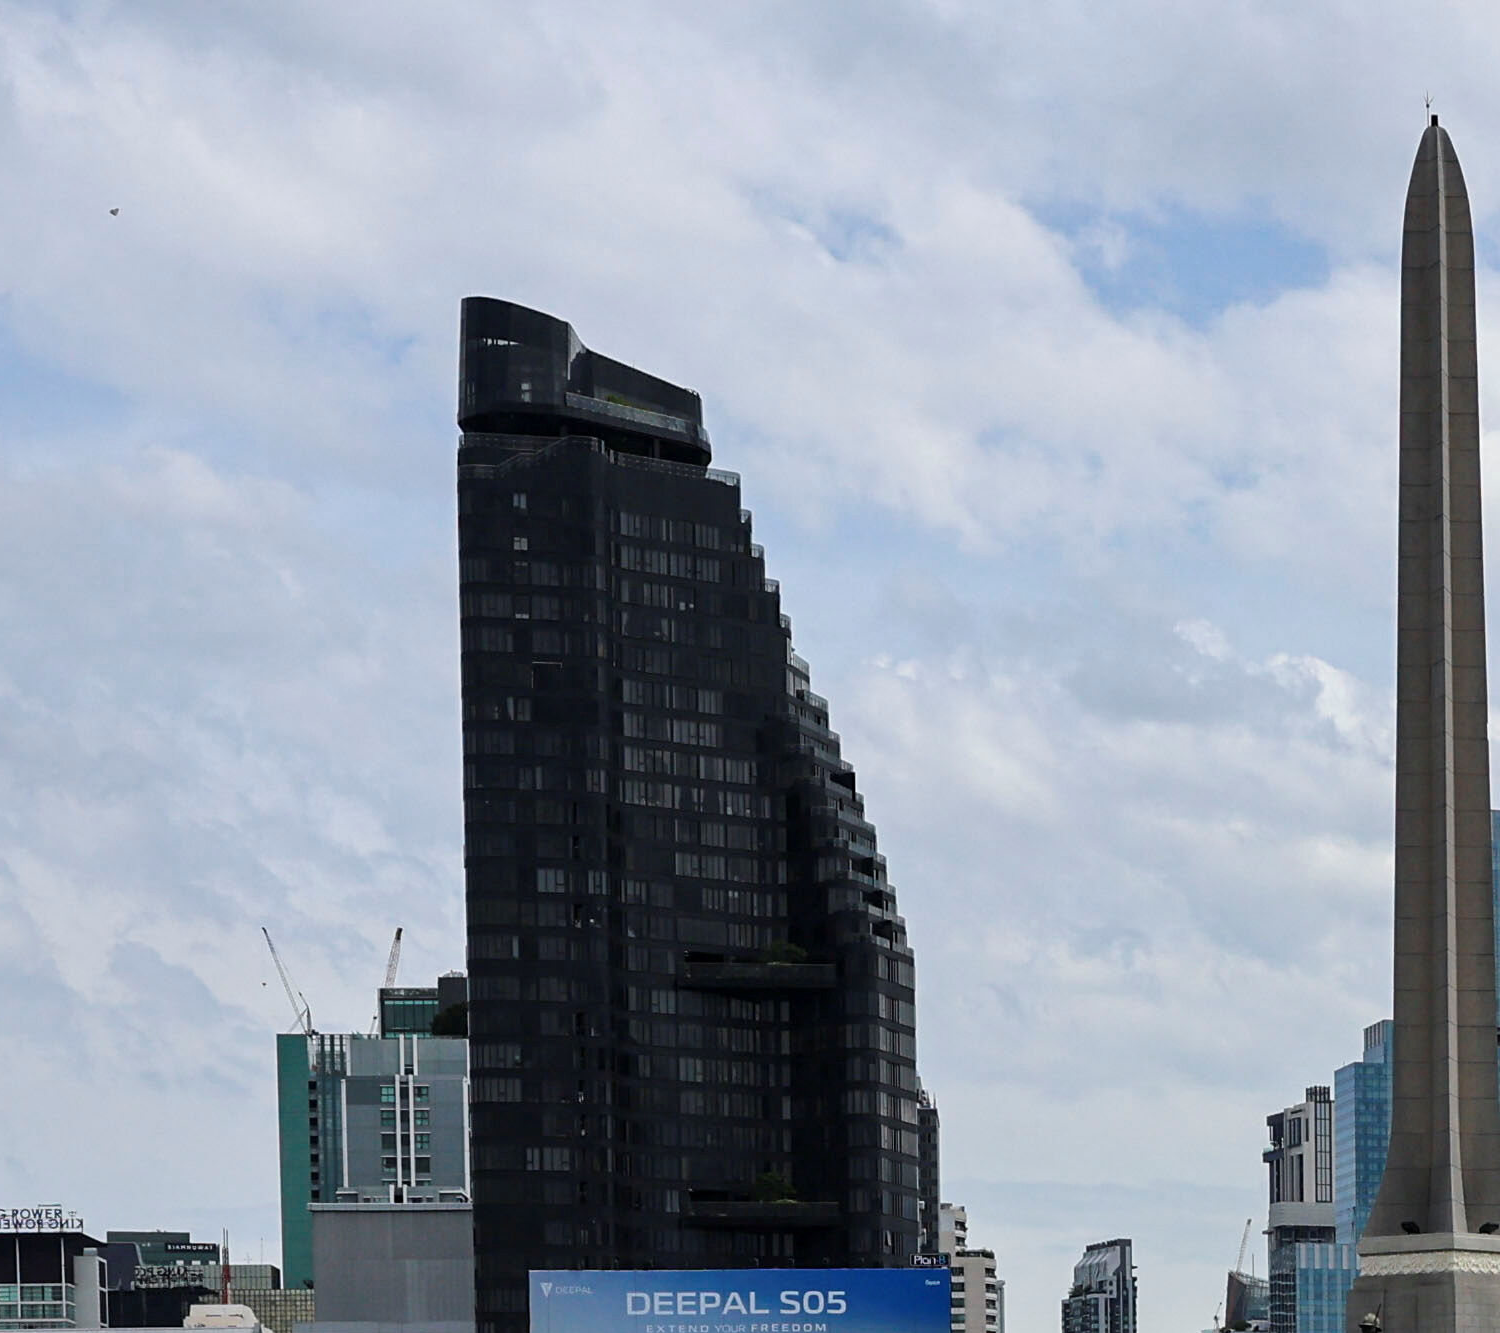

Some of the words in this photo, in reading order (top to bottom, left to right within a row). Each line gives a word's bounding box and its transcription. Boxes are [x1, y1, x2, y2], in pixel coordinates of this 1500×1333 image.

[555, 1286, 592, 1295] DEEPAL
[627, 1292, 769, 1316] DEEPAL
[780, 1290, 846, 1315] S05
[646, 1324, 709, 1333] EXTEND
[714, 1324, 746, 1333] YOUR
[750, 1323, 827, 1333] FREEDOM
